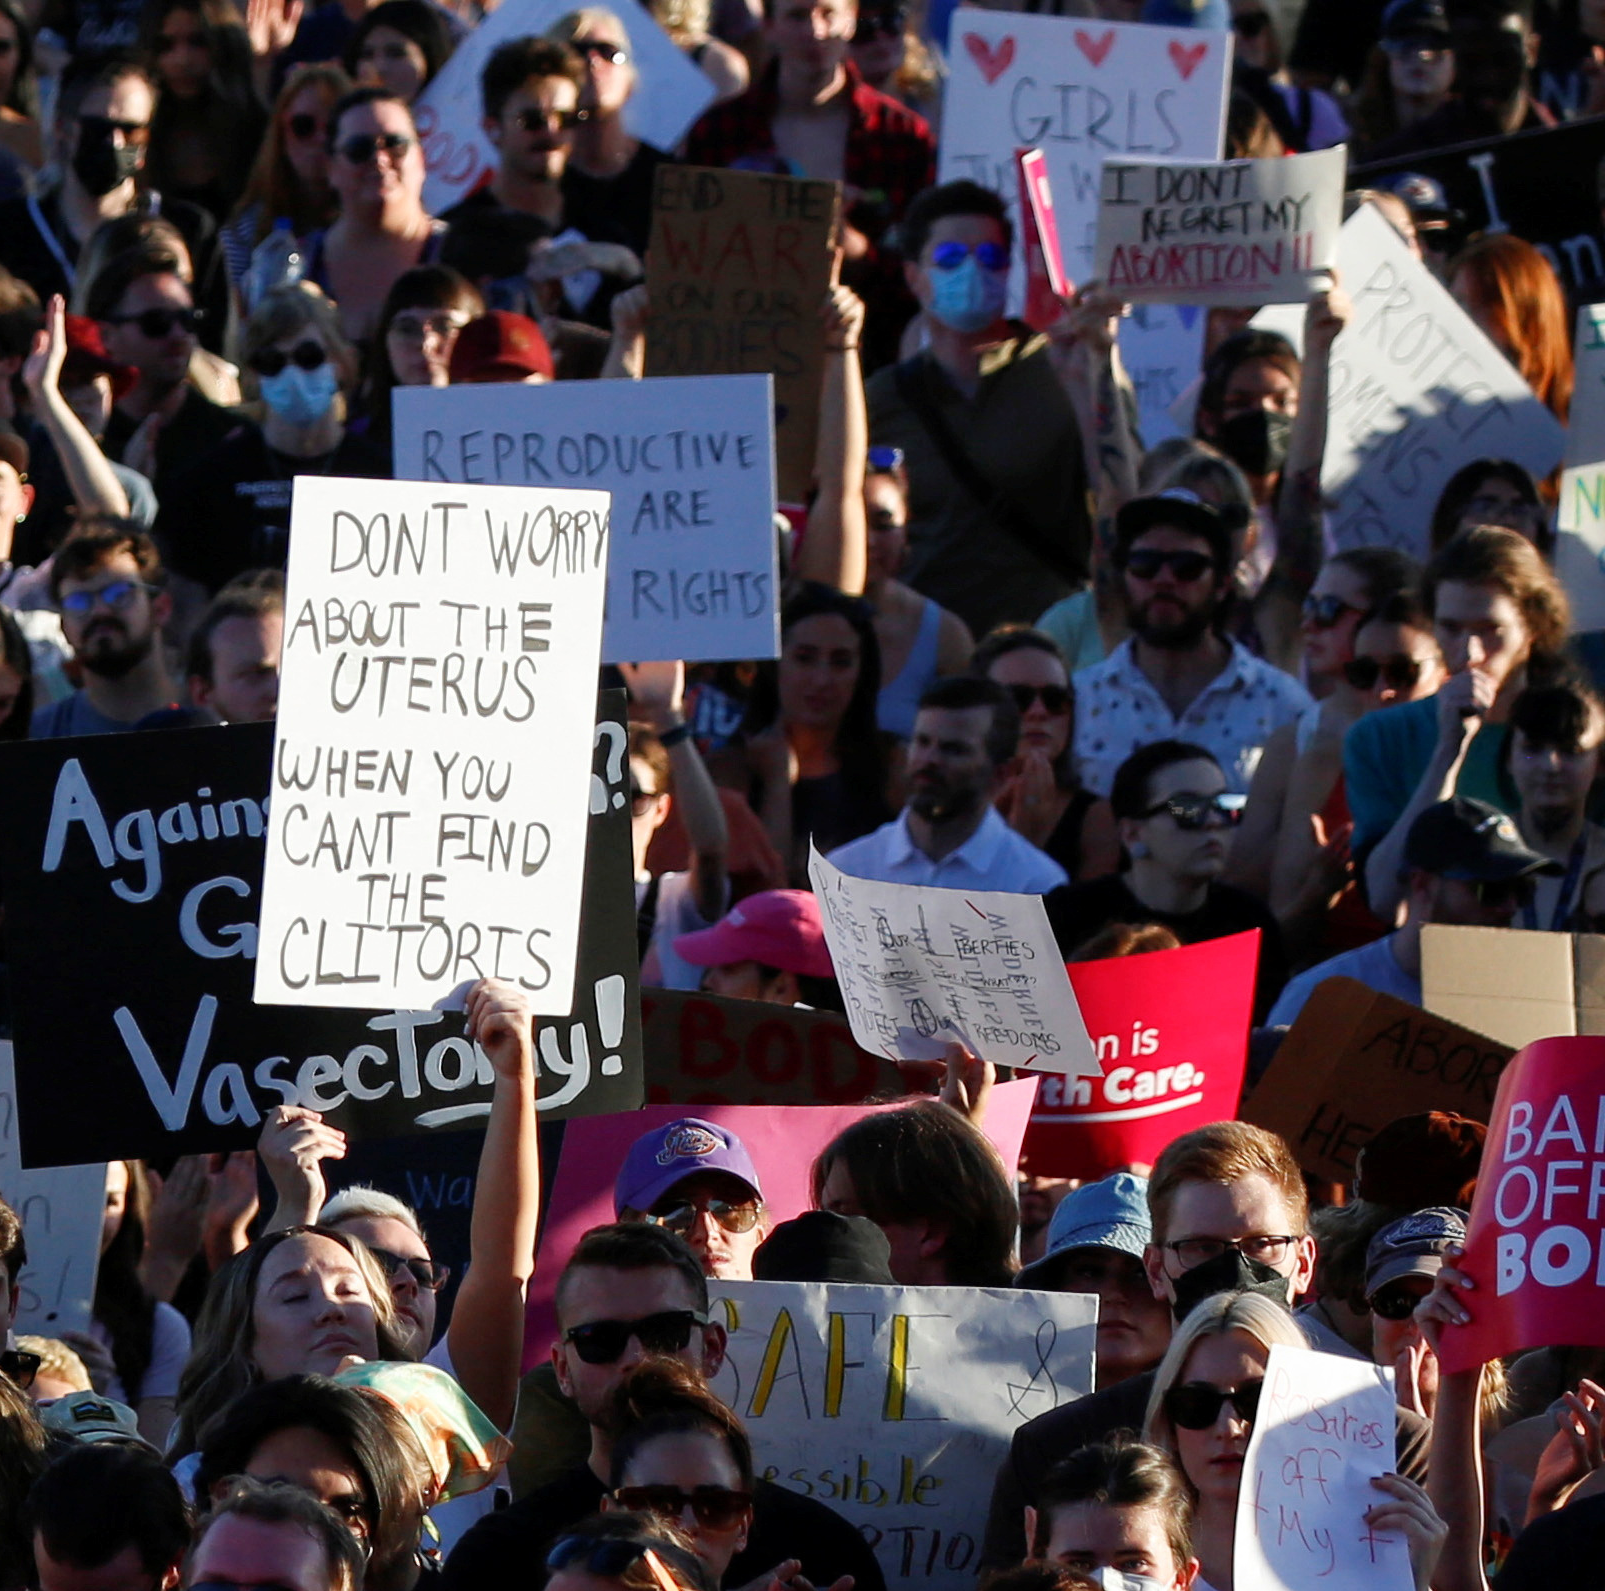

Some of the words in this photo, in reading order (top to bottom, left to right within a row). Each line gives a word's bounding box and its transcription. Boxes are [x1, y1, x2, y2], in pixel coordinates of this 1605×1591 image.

[1010, 75, 1183, 154] GIRLS
[1157, 163, 1252, 202] DONT
[1142, 204, 1250, 243] REGRET
[1262, 195, 1309, 236] MY
[660, 214, 808, 287] WAR
[1109, 236, 1282, 286] ABORTION
[1351, 259, 1514, 443] PROTECT
[423, 429, 756, 485] REPRODUCTIVE
[331, 502, 468, 578] DONT
[485, 505, 610, 578] WORRY
[632, 489, 715, 536] ARE
[631, 568, 770, 620] RIGHTS
[288, 599, 420, 654] ABOUT
[440, 602, 552, 652] THE
[331, 652, 538, 723] UTERUS
[277, 739, 413, 797] WHEN
[434, 751, 512, 803] YOU
[283, 804, 410, 872] CANT
[438, 813, 551, 876] FIND
[358, 873, 447, 926] THE
[280, 917, 553, 992] CLITORIS
[1128, 1021, 1160, 1056] is
[1107, 1062, 1206, 1103] Care.
[1267, 1366, 1384, 1449] Rosaries
[1278, 1504, 1335, 1576] My
